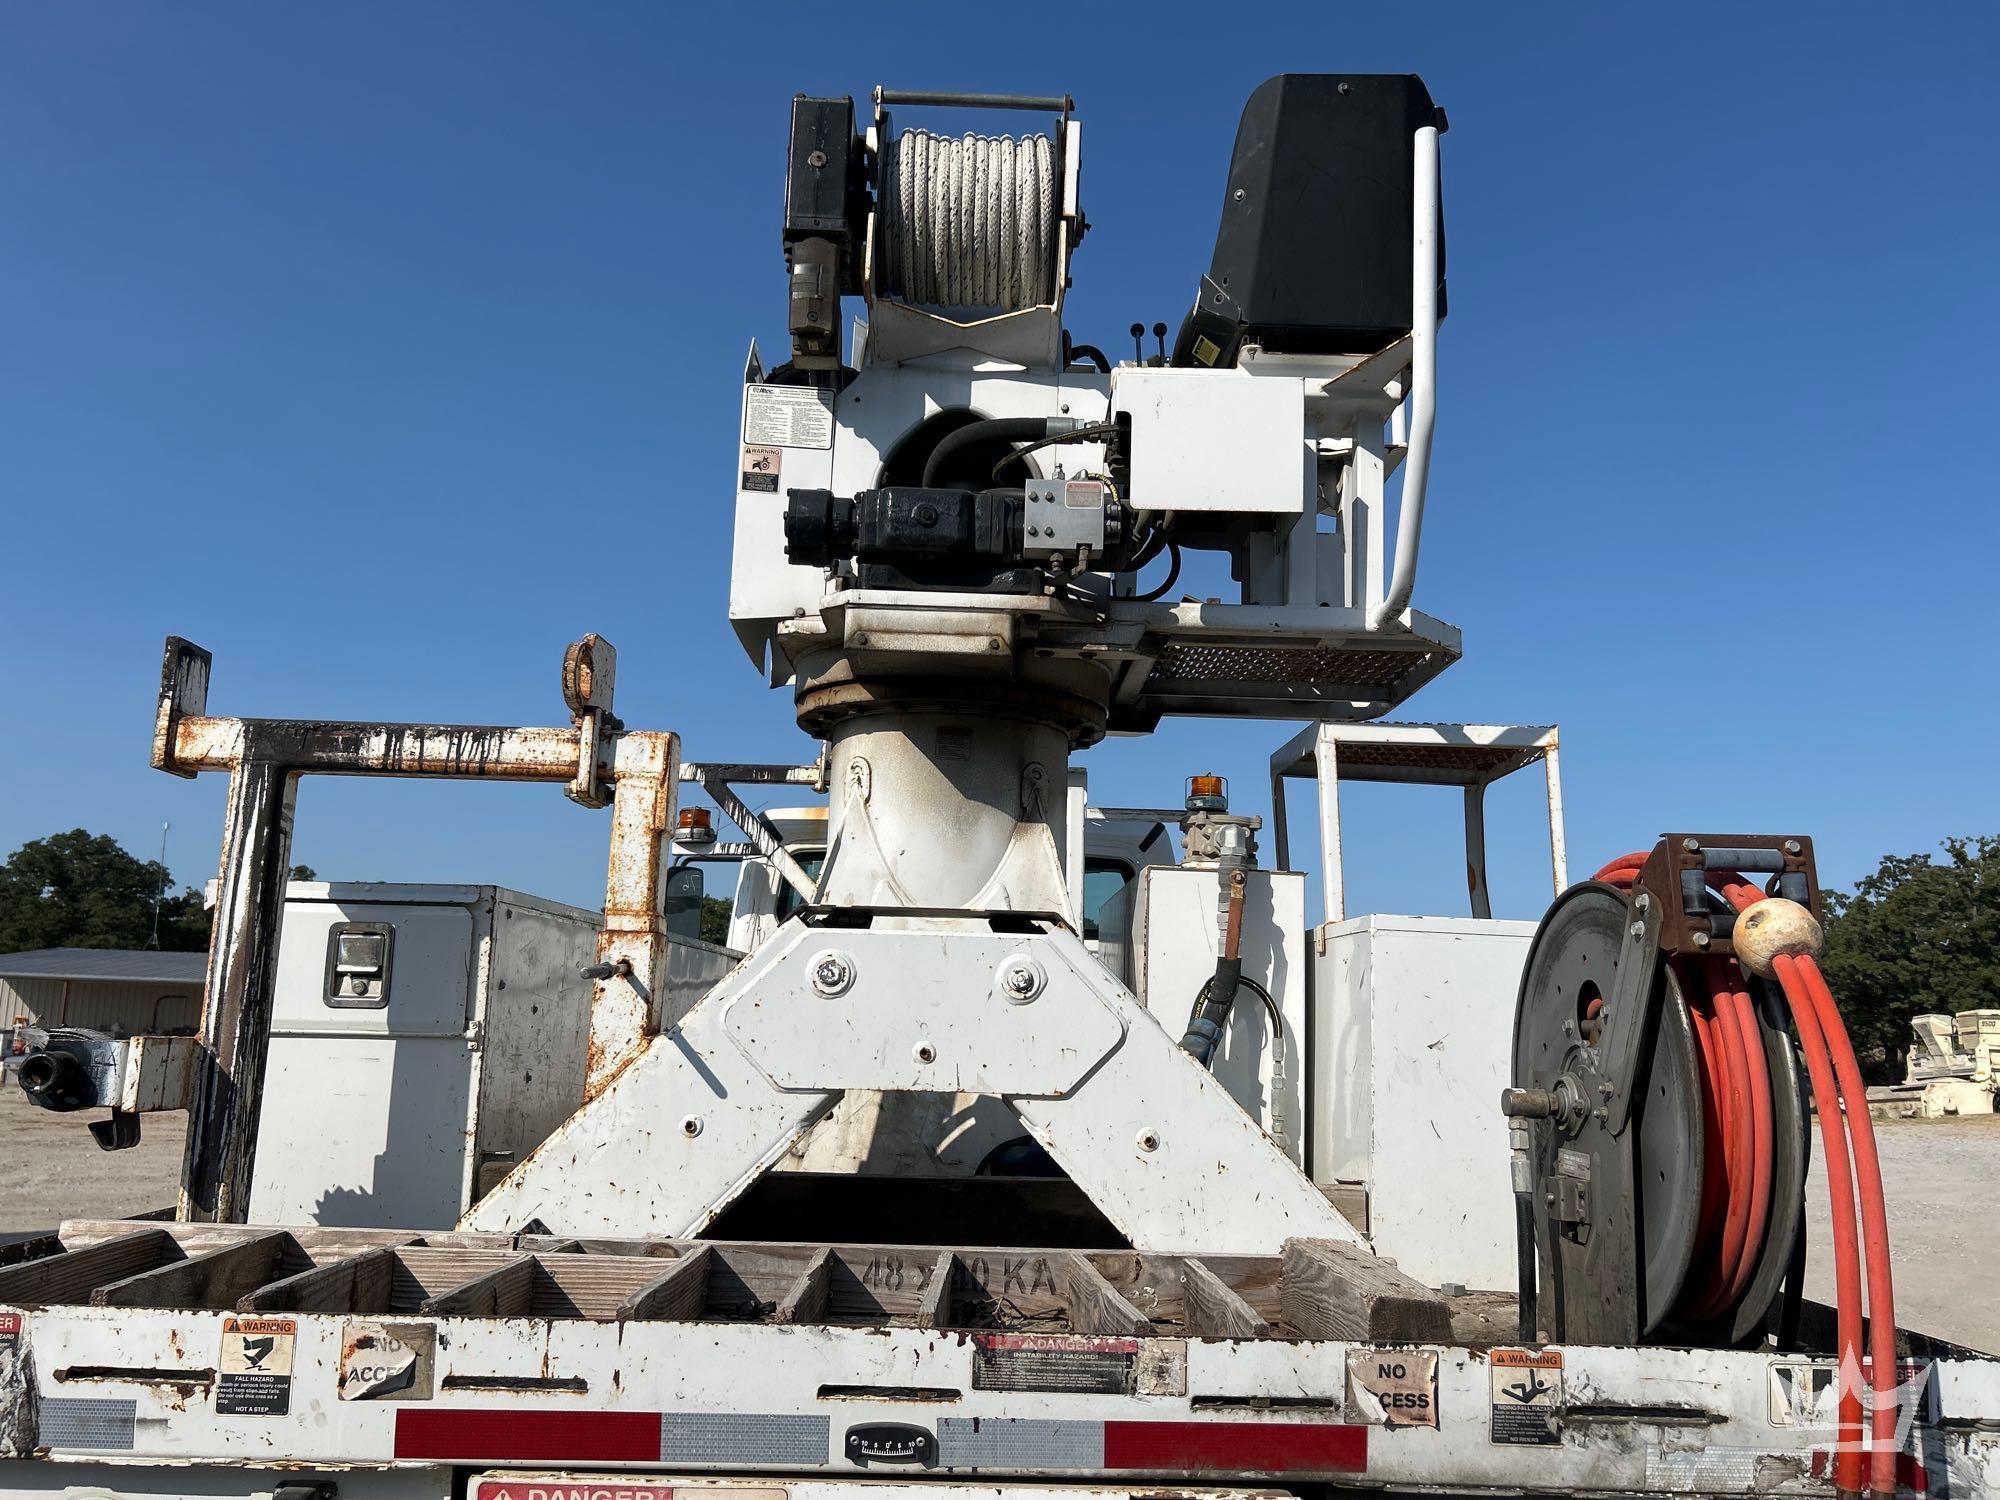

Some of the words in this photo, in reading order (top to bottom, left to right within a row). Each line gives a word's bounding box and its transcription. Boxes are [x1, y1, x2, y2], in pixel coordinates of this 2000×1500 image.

[863, 1255, 903, 1291] 48
[1003, 1257, 1057, 1295] KA
[243, 1321, 291, 1332] WARNING
[1038, 1339, 1094, 1350] DANGER
[1013, 1351, 1062, 1359] INSTABILITY
[1508, 1354, 1557, 1365] WARNING
[1378, 1363, 1406, 1379] NO
[1378, 1392, 1430, 1408] CESS
